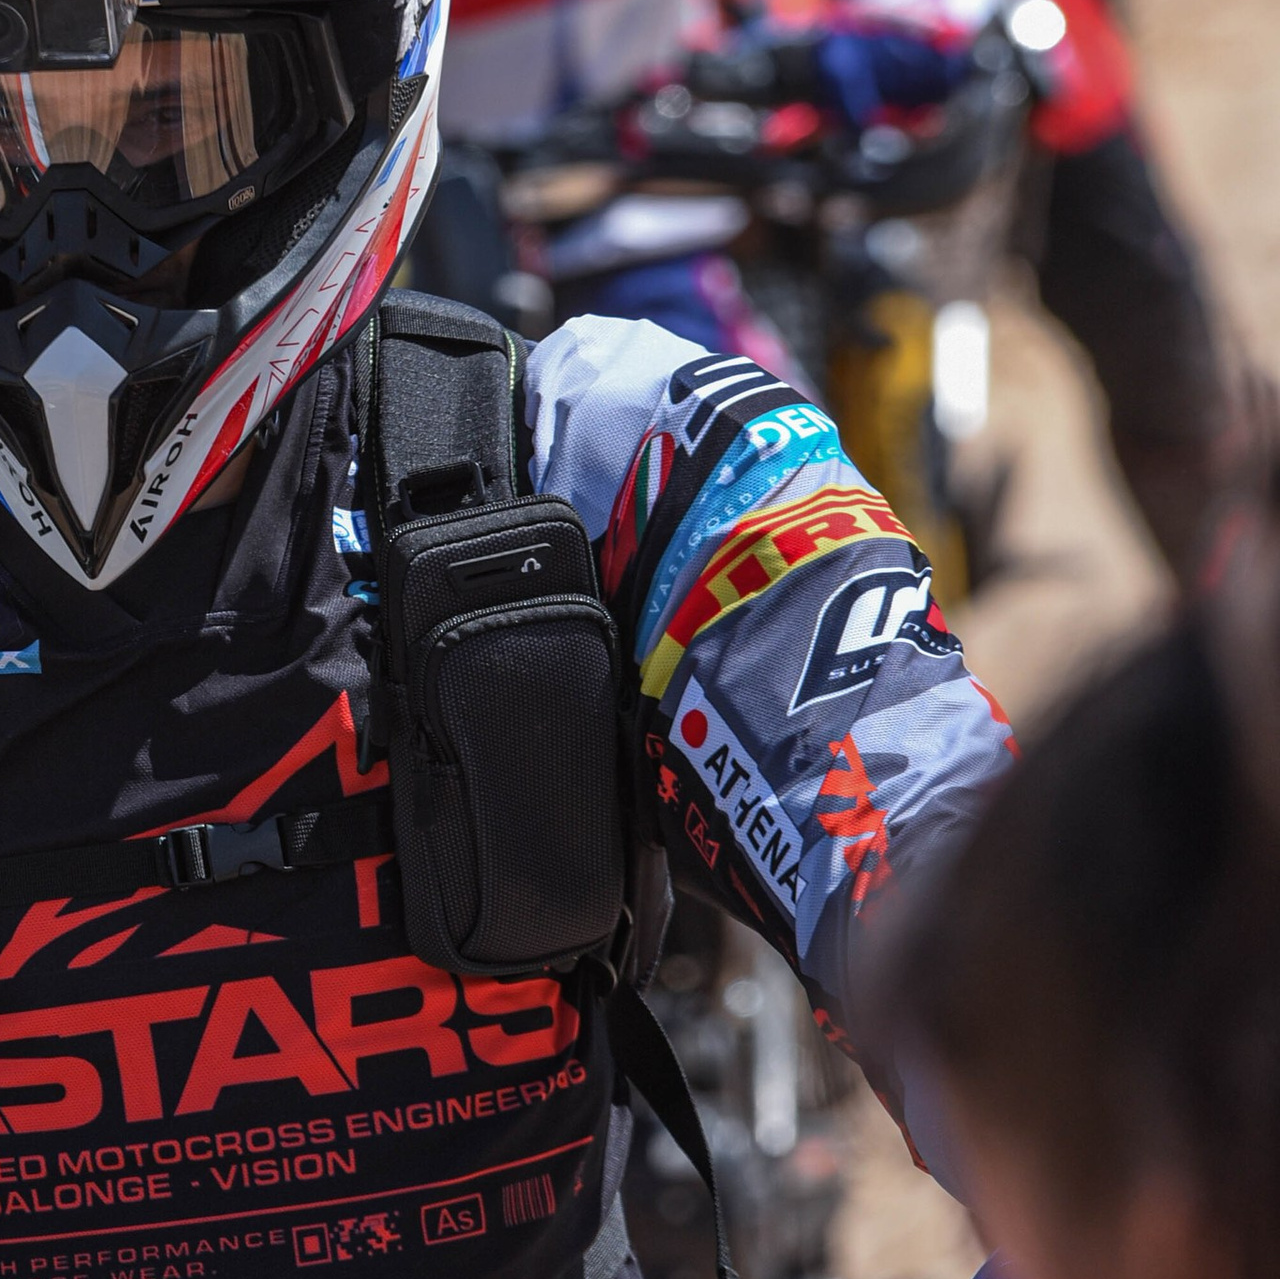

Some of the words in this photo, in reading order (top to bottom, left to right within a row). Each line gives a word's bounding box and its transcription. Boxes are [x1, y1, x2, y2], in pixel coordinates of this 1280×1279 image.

[129, 413, 198, 543] AIROH
[703, 743, 803, 904] ATHENA
[56, 1117, 336, 1177] MOTOCROSS
[210, 1149, 357, 1191] VISION
[436, 1207, 475, 1236] As
[30, 1229, 287, 1273] PERFORMANCE
